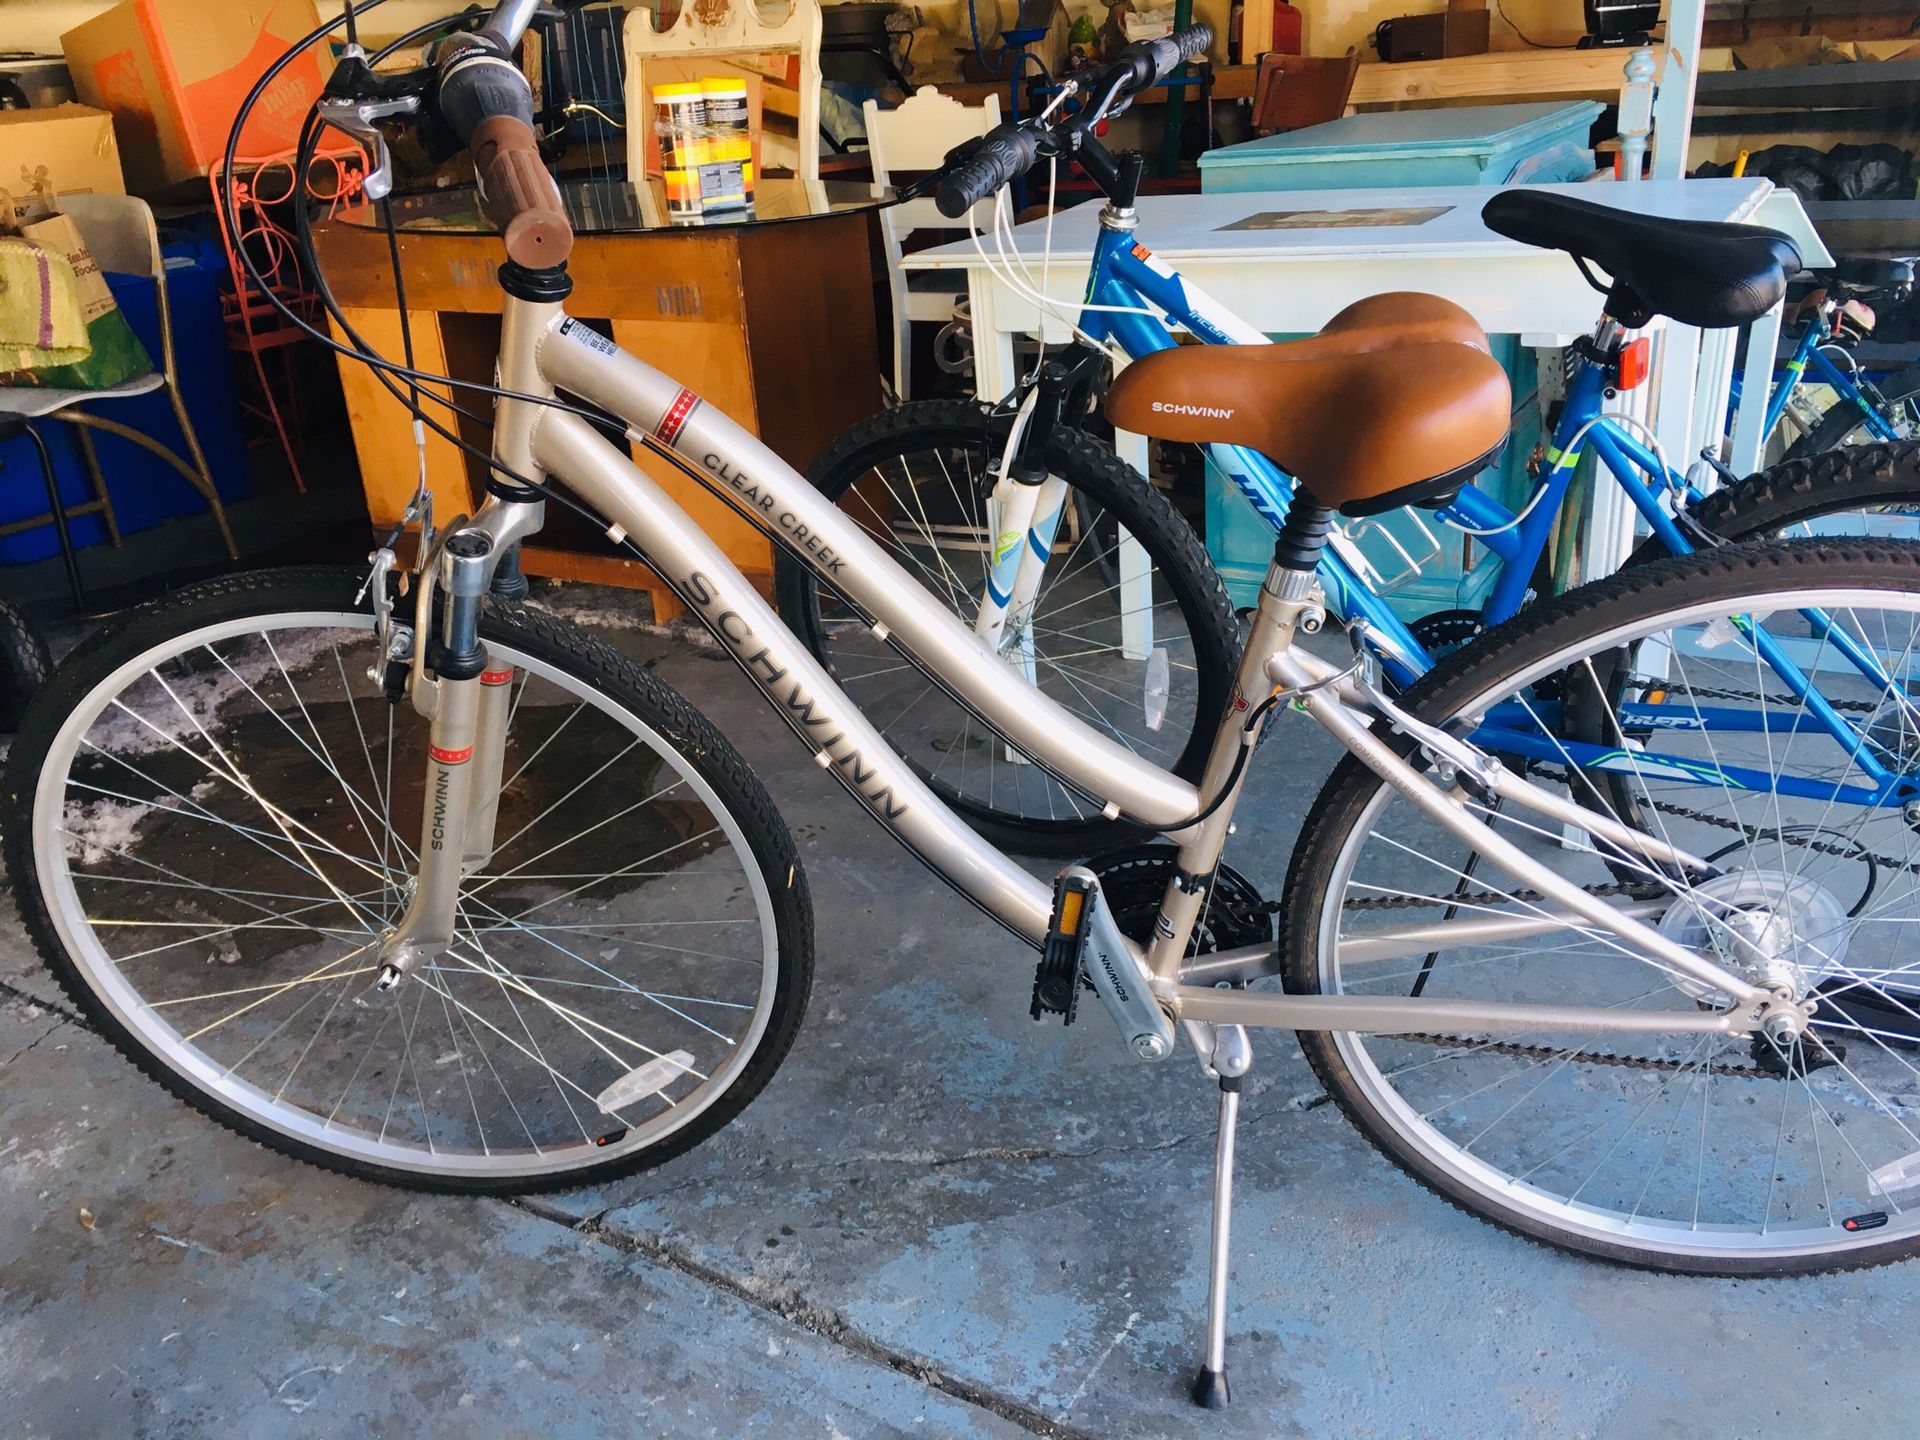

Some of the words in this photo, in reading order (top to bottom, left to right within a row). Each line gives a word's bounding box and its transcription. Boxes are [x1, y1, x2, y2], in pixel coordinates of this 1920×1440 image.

[1151, 401, 1232, 420] SCHWINN
[703, 453, 775, 512] CLEAR
[779, 512, 846, 575] CREEK
[680, 570, 911, 821] SCHWINN
[1622, 714, 1709, 728] HUFFY
[1348, 736, 1393, 778] COMFORT
[1393, 776, 1425, 802] SERIES
[430, 769, 450, 851] SCHWINN
[1098, 953, 1130, 1003] SCHWINN
